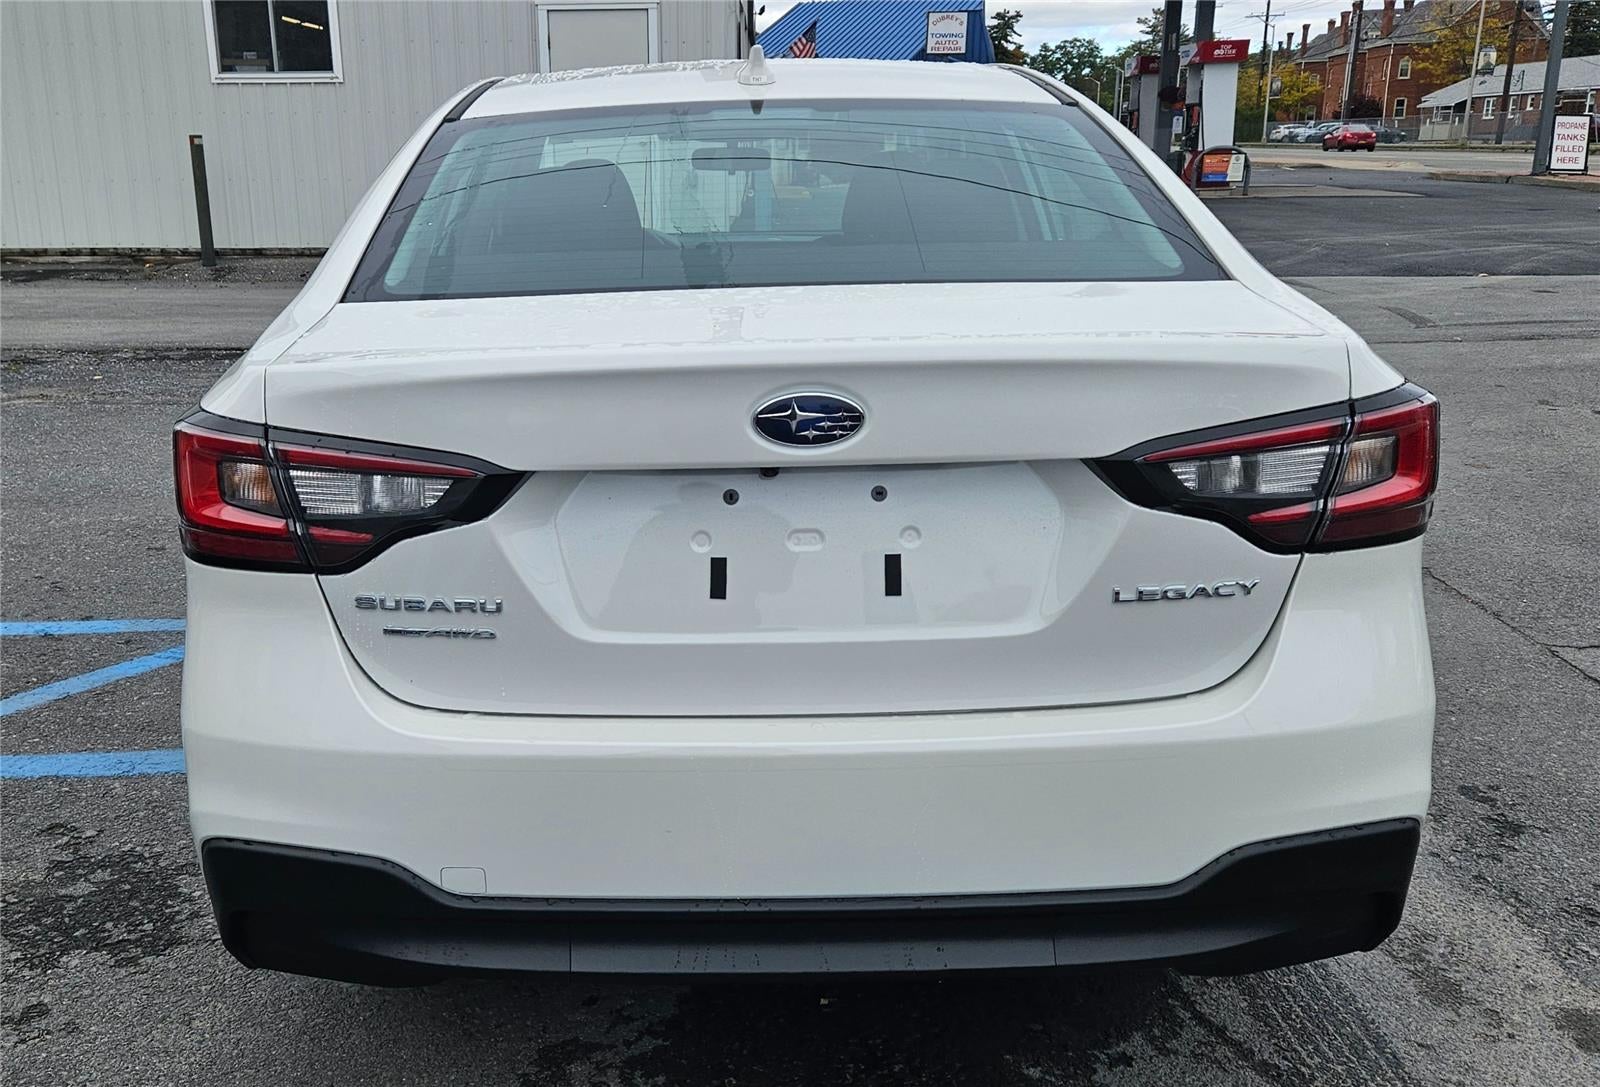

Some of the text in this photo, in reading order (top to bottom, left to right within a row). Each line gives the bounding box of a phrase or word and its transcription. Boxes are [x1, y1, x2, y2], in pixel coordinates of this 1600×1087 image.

[931, 14, 964, 26] DUBREY'S
[1557, 121, 1588, 130] PROPANE
[1556, 133, 1586, 142] TANKS
[1555, 145, 1584, 153] FILLED
[1556, 156, 1580, 164] HERE
[1111, 578, 1261, 603] LEGACY
[354, 593, 504, 613] SUBARU
